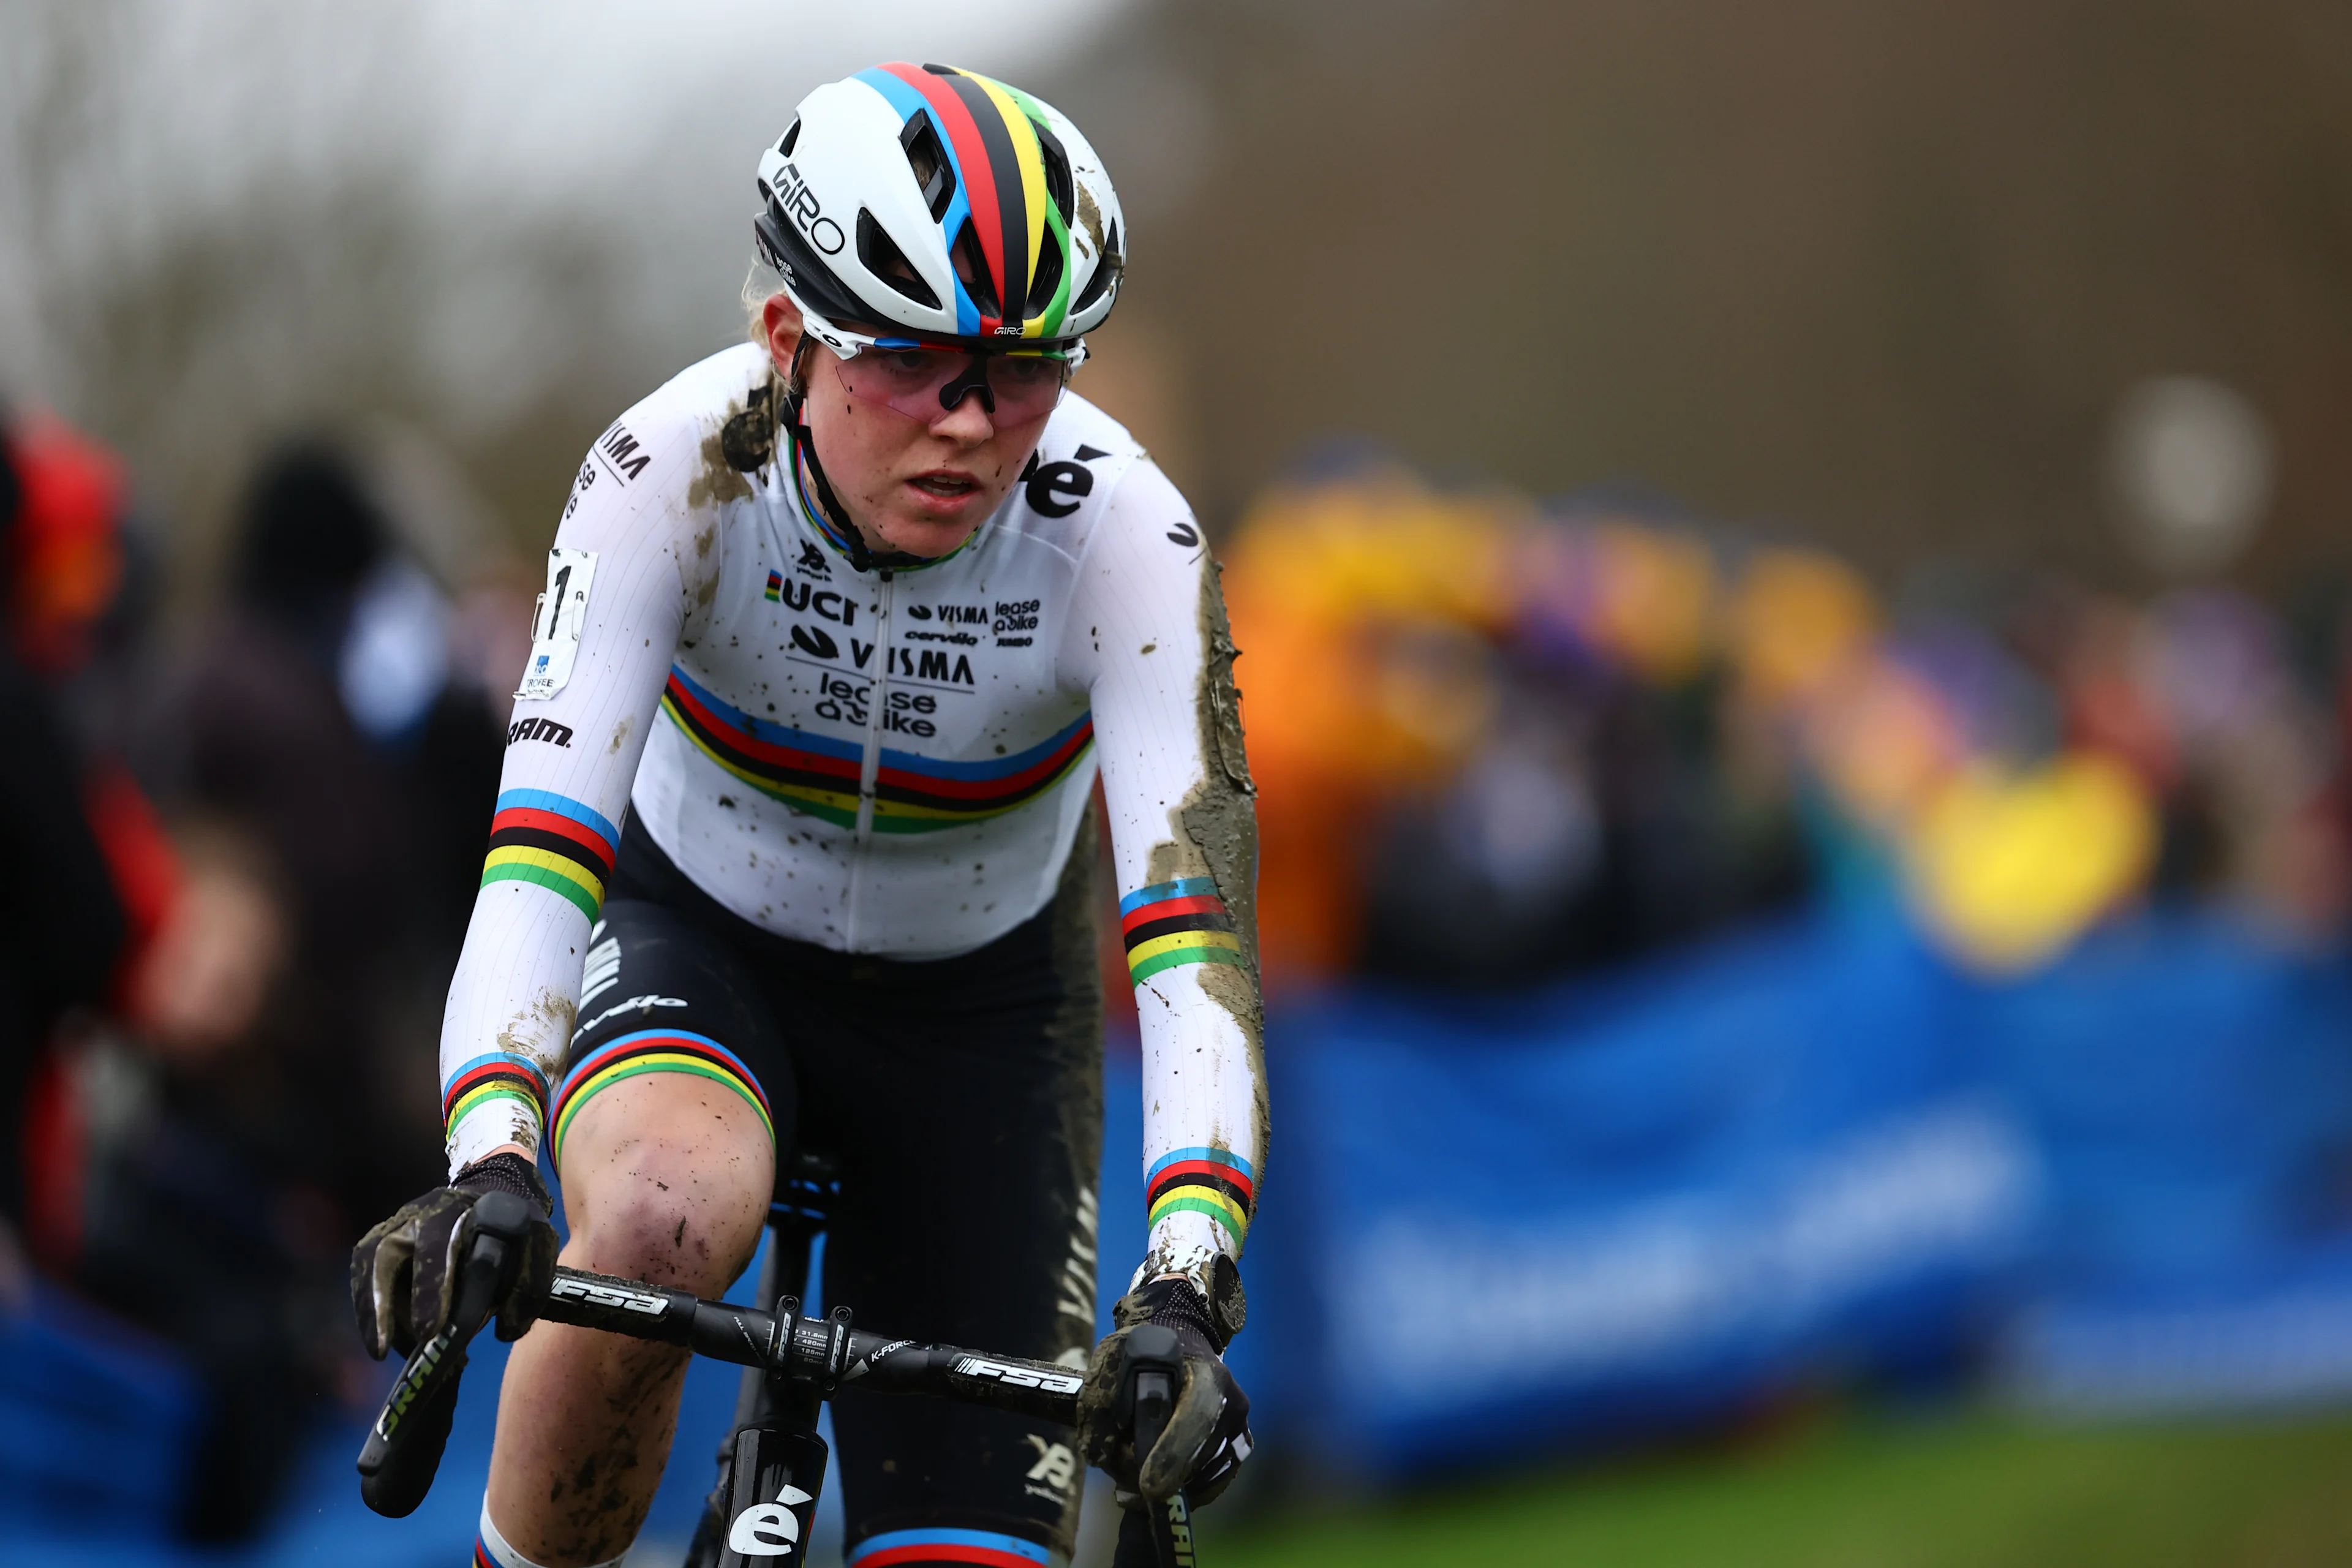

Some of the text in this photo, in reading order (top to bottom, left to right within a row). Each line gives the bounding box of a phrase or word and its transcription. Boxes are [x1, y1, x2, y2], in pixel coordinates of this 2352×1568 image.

[773, 164, 845, 255] GIRO
[994, 326, 1027, 335] GIRO
[598, 420, 651, 481] ISMA
[548, 565, 571, 640] 1
[783, 578, 855, 627] UCI
[938, 604, 988, 624] VISMA
[995, 600, 1040, 616] lease
[850, 637, 974, 685] VISMA
[1166, 1487, 1195, 1568] RA
